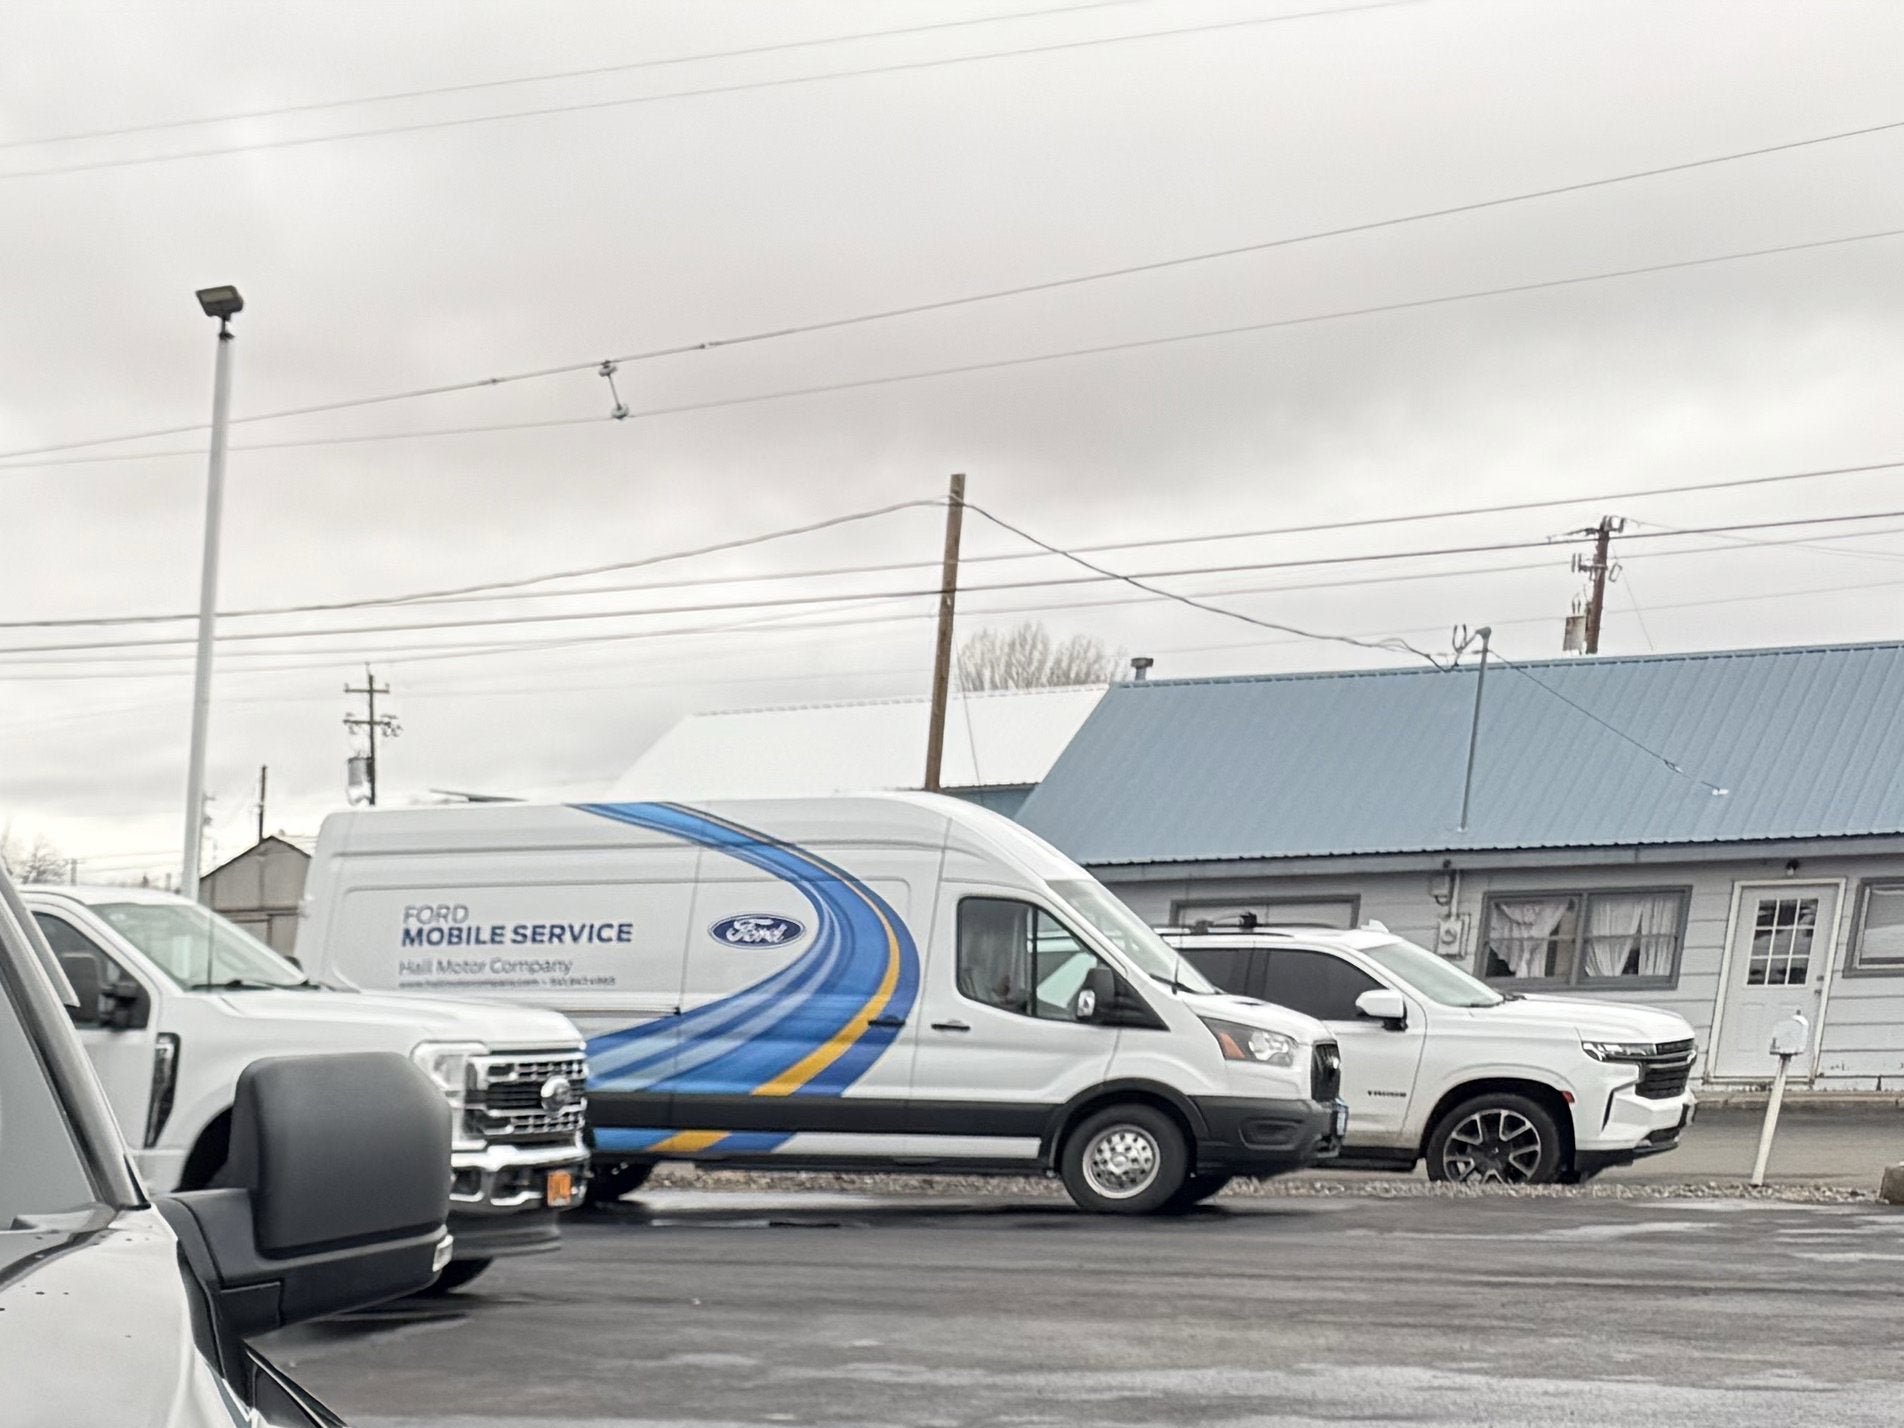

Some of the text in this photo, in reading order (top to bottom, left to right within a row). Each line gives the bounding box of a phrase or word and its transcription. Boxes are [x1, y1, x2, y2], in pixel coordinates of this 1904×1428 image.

[402, 904, 469, 925] FORD
[401, 922, 634, 947] MOBILE SERVICE
[725, 918, 788, 943] Ford
[399, 956, 573, 976] Hall Motor Company
